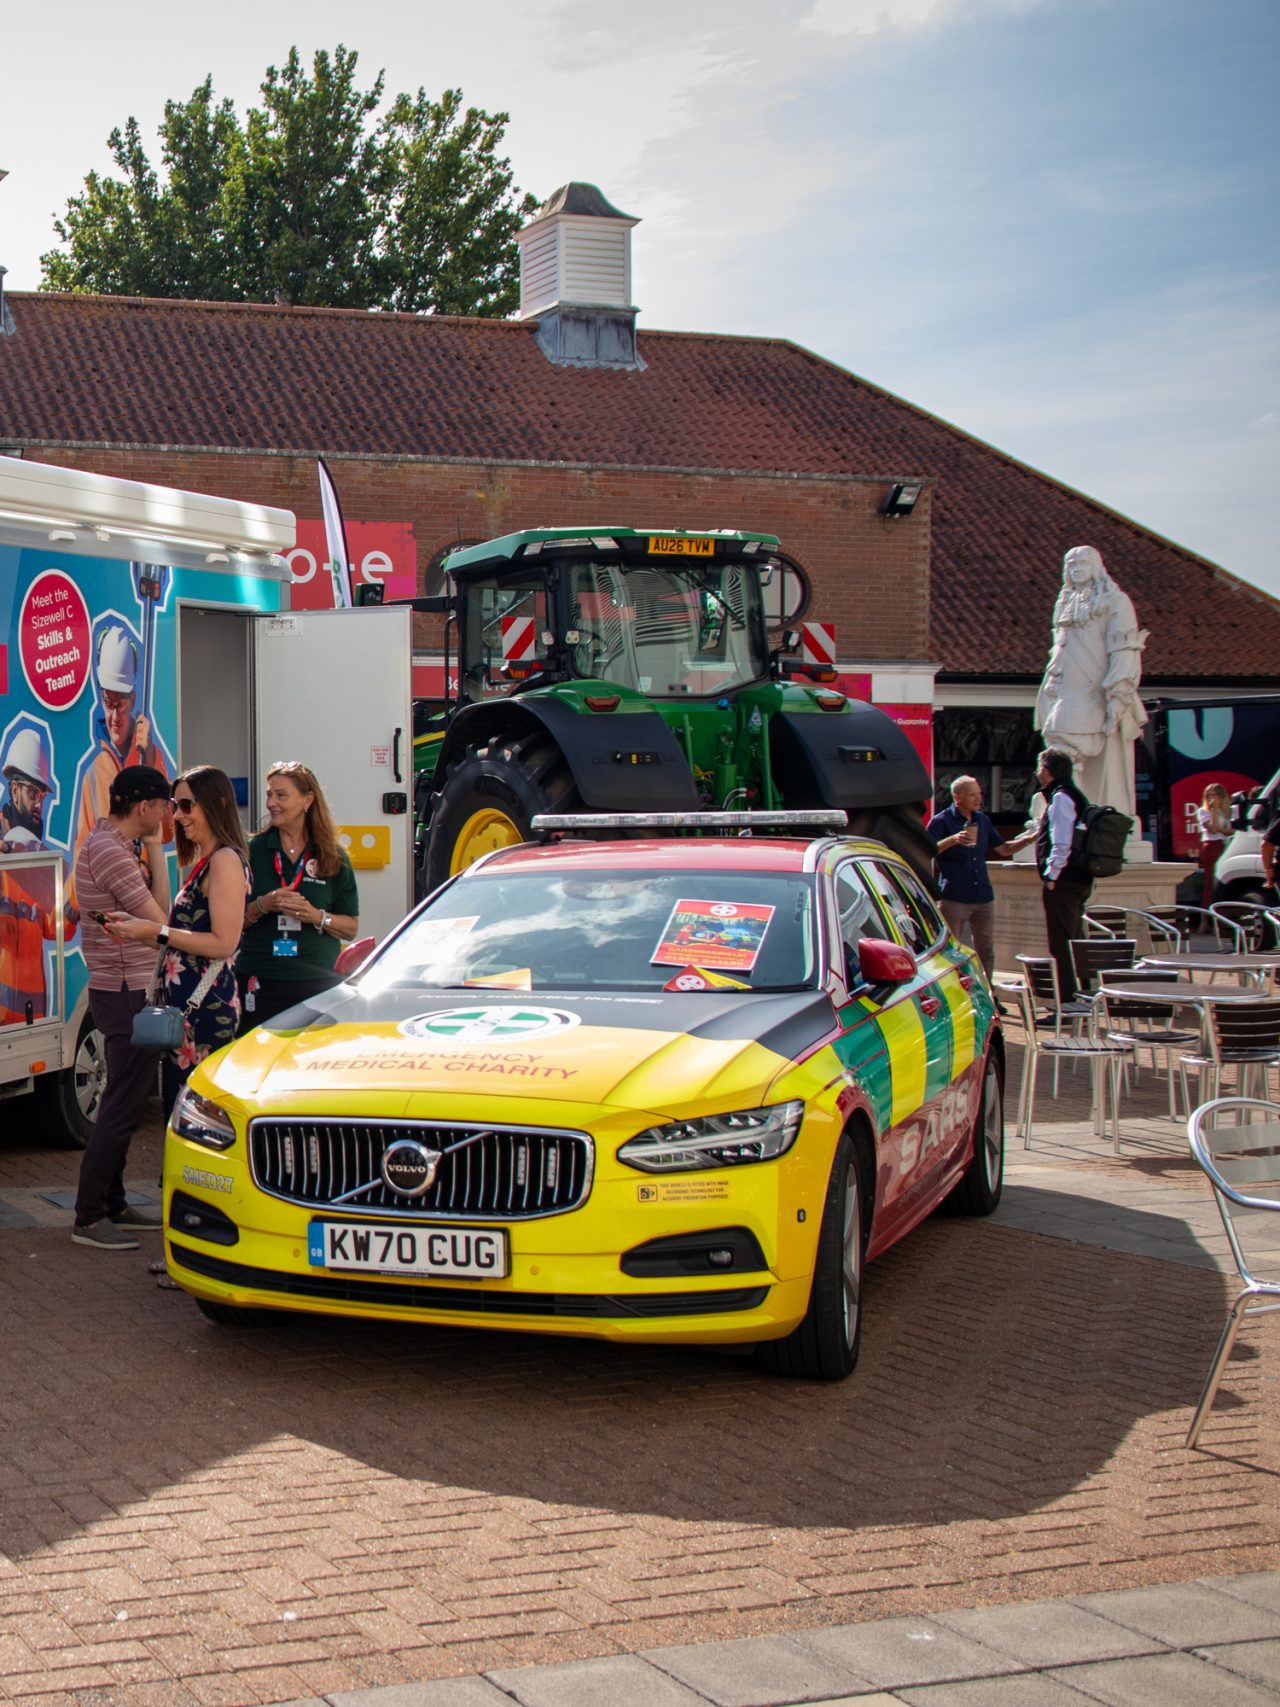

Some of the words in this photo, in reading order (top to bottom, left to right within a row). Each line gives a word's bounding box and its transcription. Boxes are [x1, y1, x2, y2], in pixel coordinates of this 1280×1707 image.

[654, 538, 684, 552] AU26
[31, 594, 52, 610] Meet
[53, 589, 69, 604] the
[31, 608, 65, 629] Sizewell
[66, 605, 74, 619] C
[37, 631, 63, 650] Skills
[65, 627, 73, 641] &
[35, 647, 80, 673] Outreach
[45, 672, 76, 693] Team!
[356, 1049, 545, 1064] EMERGENCY
[304, 1059, 434, 1071] MEDICAL
[443, 1061, 579, 1080] CHARITY
[182, 1166, 234, 1193] SMED27
[387, 1164, 427, 1174] VOLVO
[311, 1248, 323, 1258] GB
[330, 1228, 416, 1265] KW70
[428, 1234, 496, 1269] CUG
